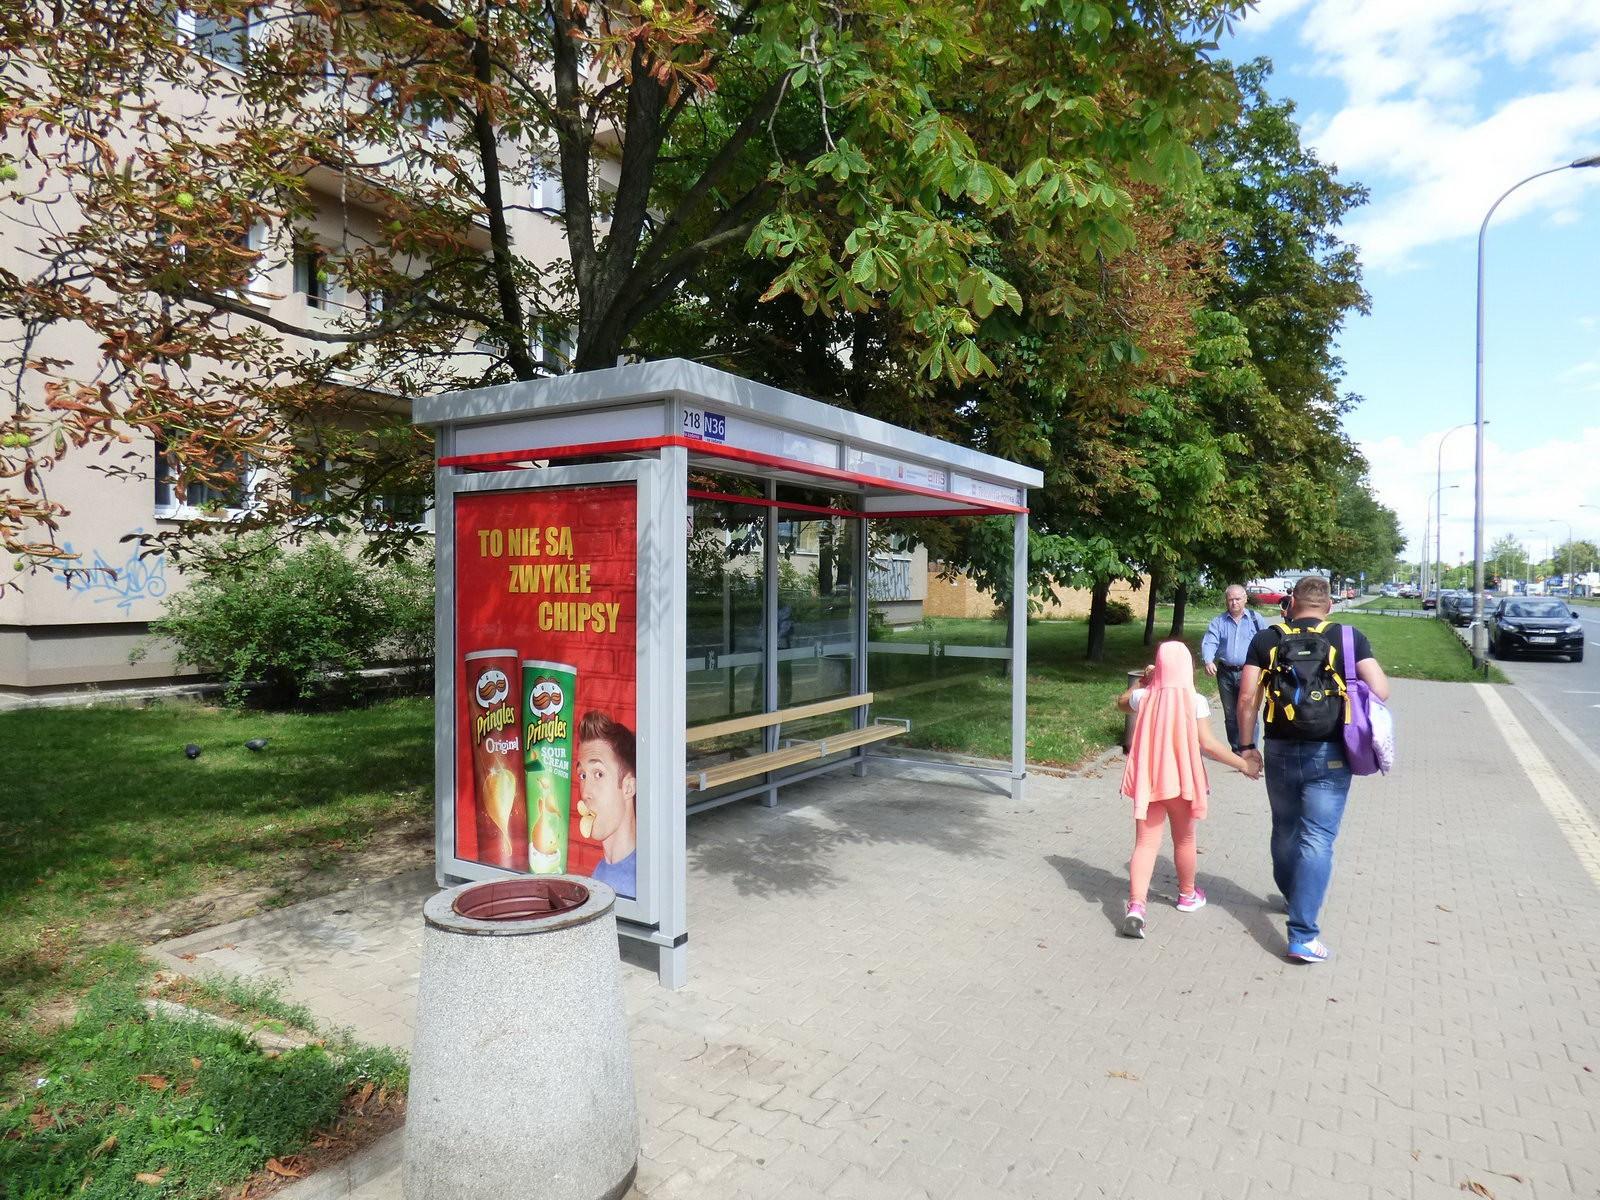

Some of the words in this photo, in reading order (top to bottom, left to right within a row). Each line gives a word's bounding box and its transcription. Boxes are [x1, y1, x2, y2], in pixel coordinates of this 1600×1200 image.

[683, 410, 701, 429] 218
[704, 416, 725, 436] N36
[478, 528, 503, 558] TO
[508, 527, 541, 557] NIE
[545, 526, 574, 561] SĄ
[508, 564, 592, 594] ZWYKŁE
[538, 601, 620, 633] CHIPSY
[477, 702, 515, 745] Pringles
[526, 715, 567, 751] Pringles
[485, 736, 520, 755] Original
[541, 746, 566, 758] SOUR
[543, 755, 569, 770] CREAM
